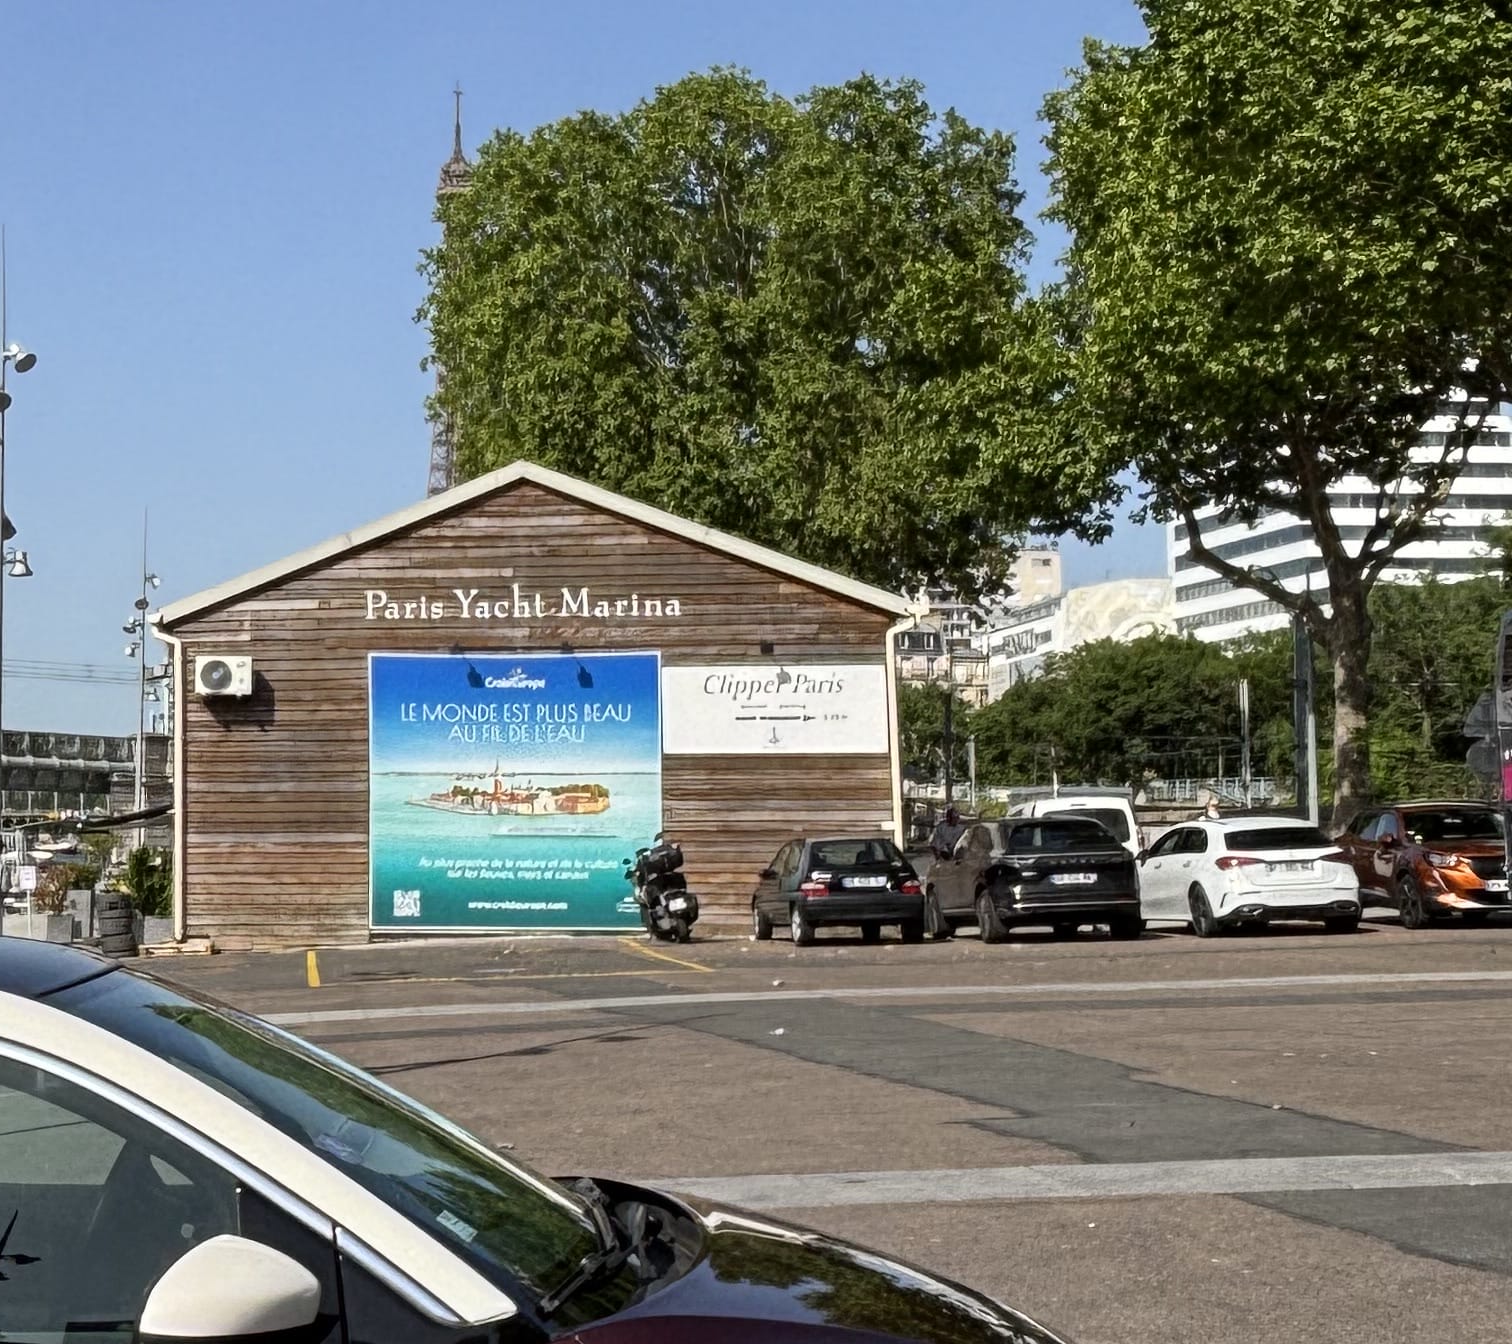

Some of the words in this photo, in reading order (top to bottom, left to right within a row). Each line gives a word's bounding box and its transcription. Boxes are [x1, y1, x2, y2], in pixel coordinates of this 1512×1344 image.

[364, 589, 444, 620] Paris
[453, 584, 546, 619] Yacht
[561, 588, 682, 618] Marina
[792, 672, 845, 694] Paris
[401, 703, 417, 722] LE
[423, 703, 498, 722] MONDE
[503, 703, 531, 722] EST
[537, 703, 578, 722] PLUS
[584, 703, 632, 722] BEAU
[447, 724, 477, 743] AU
[482, 724, 507, 743] FIL
[509, 724, 529, 743] DE
[535, 724, 585, 743] L'EAU
